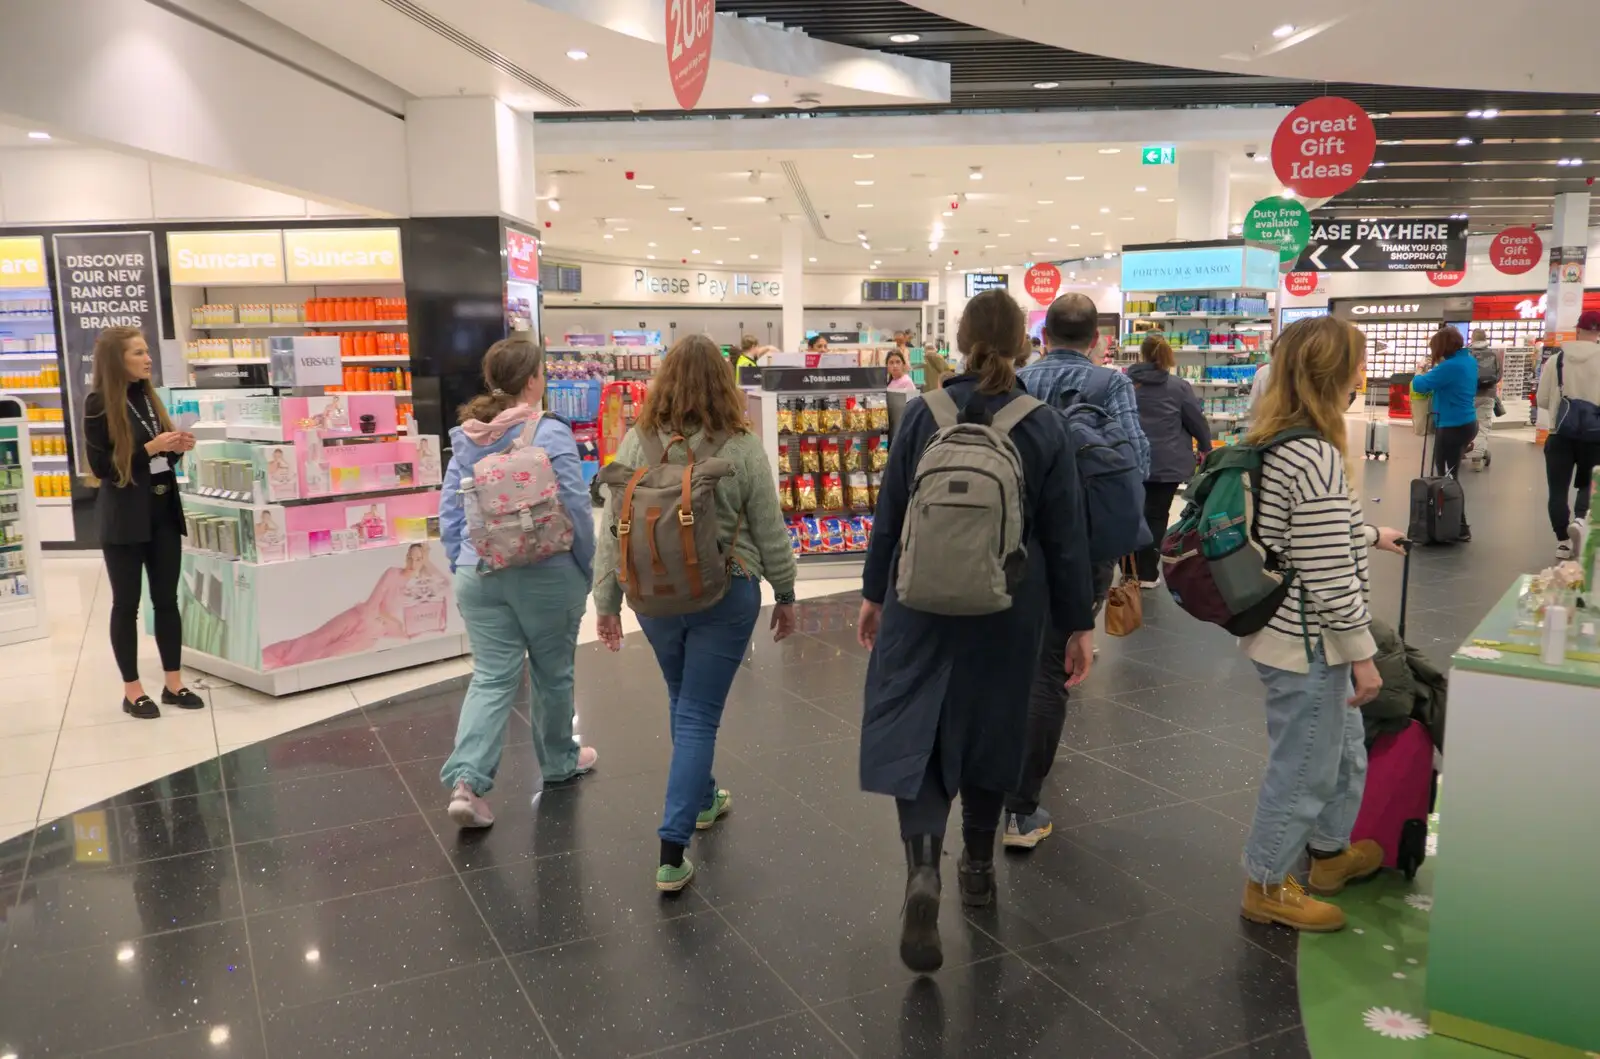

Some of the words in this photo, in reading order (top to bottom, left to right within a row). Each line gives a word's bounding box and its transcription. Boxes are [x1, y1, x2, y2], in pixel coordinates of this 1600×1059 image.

[1291, 114, 1357, 135] Great
[1300, 136, 1346, 156] Gift
[1290, 160, 1353, 180] Ideas
[1253, 210, 1277, 220] Duty
[1280, 208, 1302, 217] Free
[1255, 218, 1300, 229] available
[1261, 230, 1272, 238] to
[1273, 229, 1293, 238] ALL
[1356, 224, 1393, 240] PAY
[1398, 223, 1449, 240] HERE
[1500, 235, 1534, 245] Great
[1381, 244, 1411, 252] THANK
[1412, 244, 1428, 252] YOU
[1430, 244, 1448, 252] FOR
[1504, 245, 1528, 255] Gift
[66, 254, 144, 268] DISCOVER
[178, 248, 277, 269] Suncare
[294, 246, 394, 267] Suncare
[1390, 252, 1436, 260] SHOPPING
[1436, 252, 1447, 260] AT
[1499, 256, 1532, 266] Ideas
[72, 271, 105, 283] OUR
[107, 269, 142, 282] NEW
[1133, 265, 1183, 277] FORTNUM
[1184, 266, 1192, 275] &
[1195, 264, 1231, 275] MASON
[1432, 272, 1458, 281] Ideas
[634, 268, 690, 294] Please
[697, 272, 729, 301] Pay
[734, 273, 781, 296] Here
[1034, 277, 1051, 285] Gift
[71, 286, 122, 298] RANGE
[125, 284, 146, 297] OF
[1031, 285, 1054, 293] Ideas
[70, 300, 148, 314] HAIRCARE
[80, 315, 142, 329] BRANDS
[301, 357, 336, 367] VERSACE
[810, 375, 851, 383] TOBLERONE
